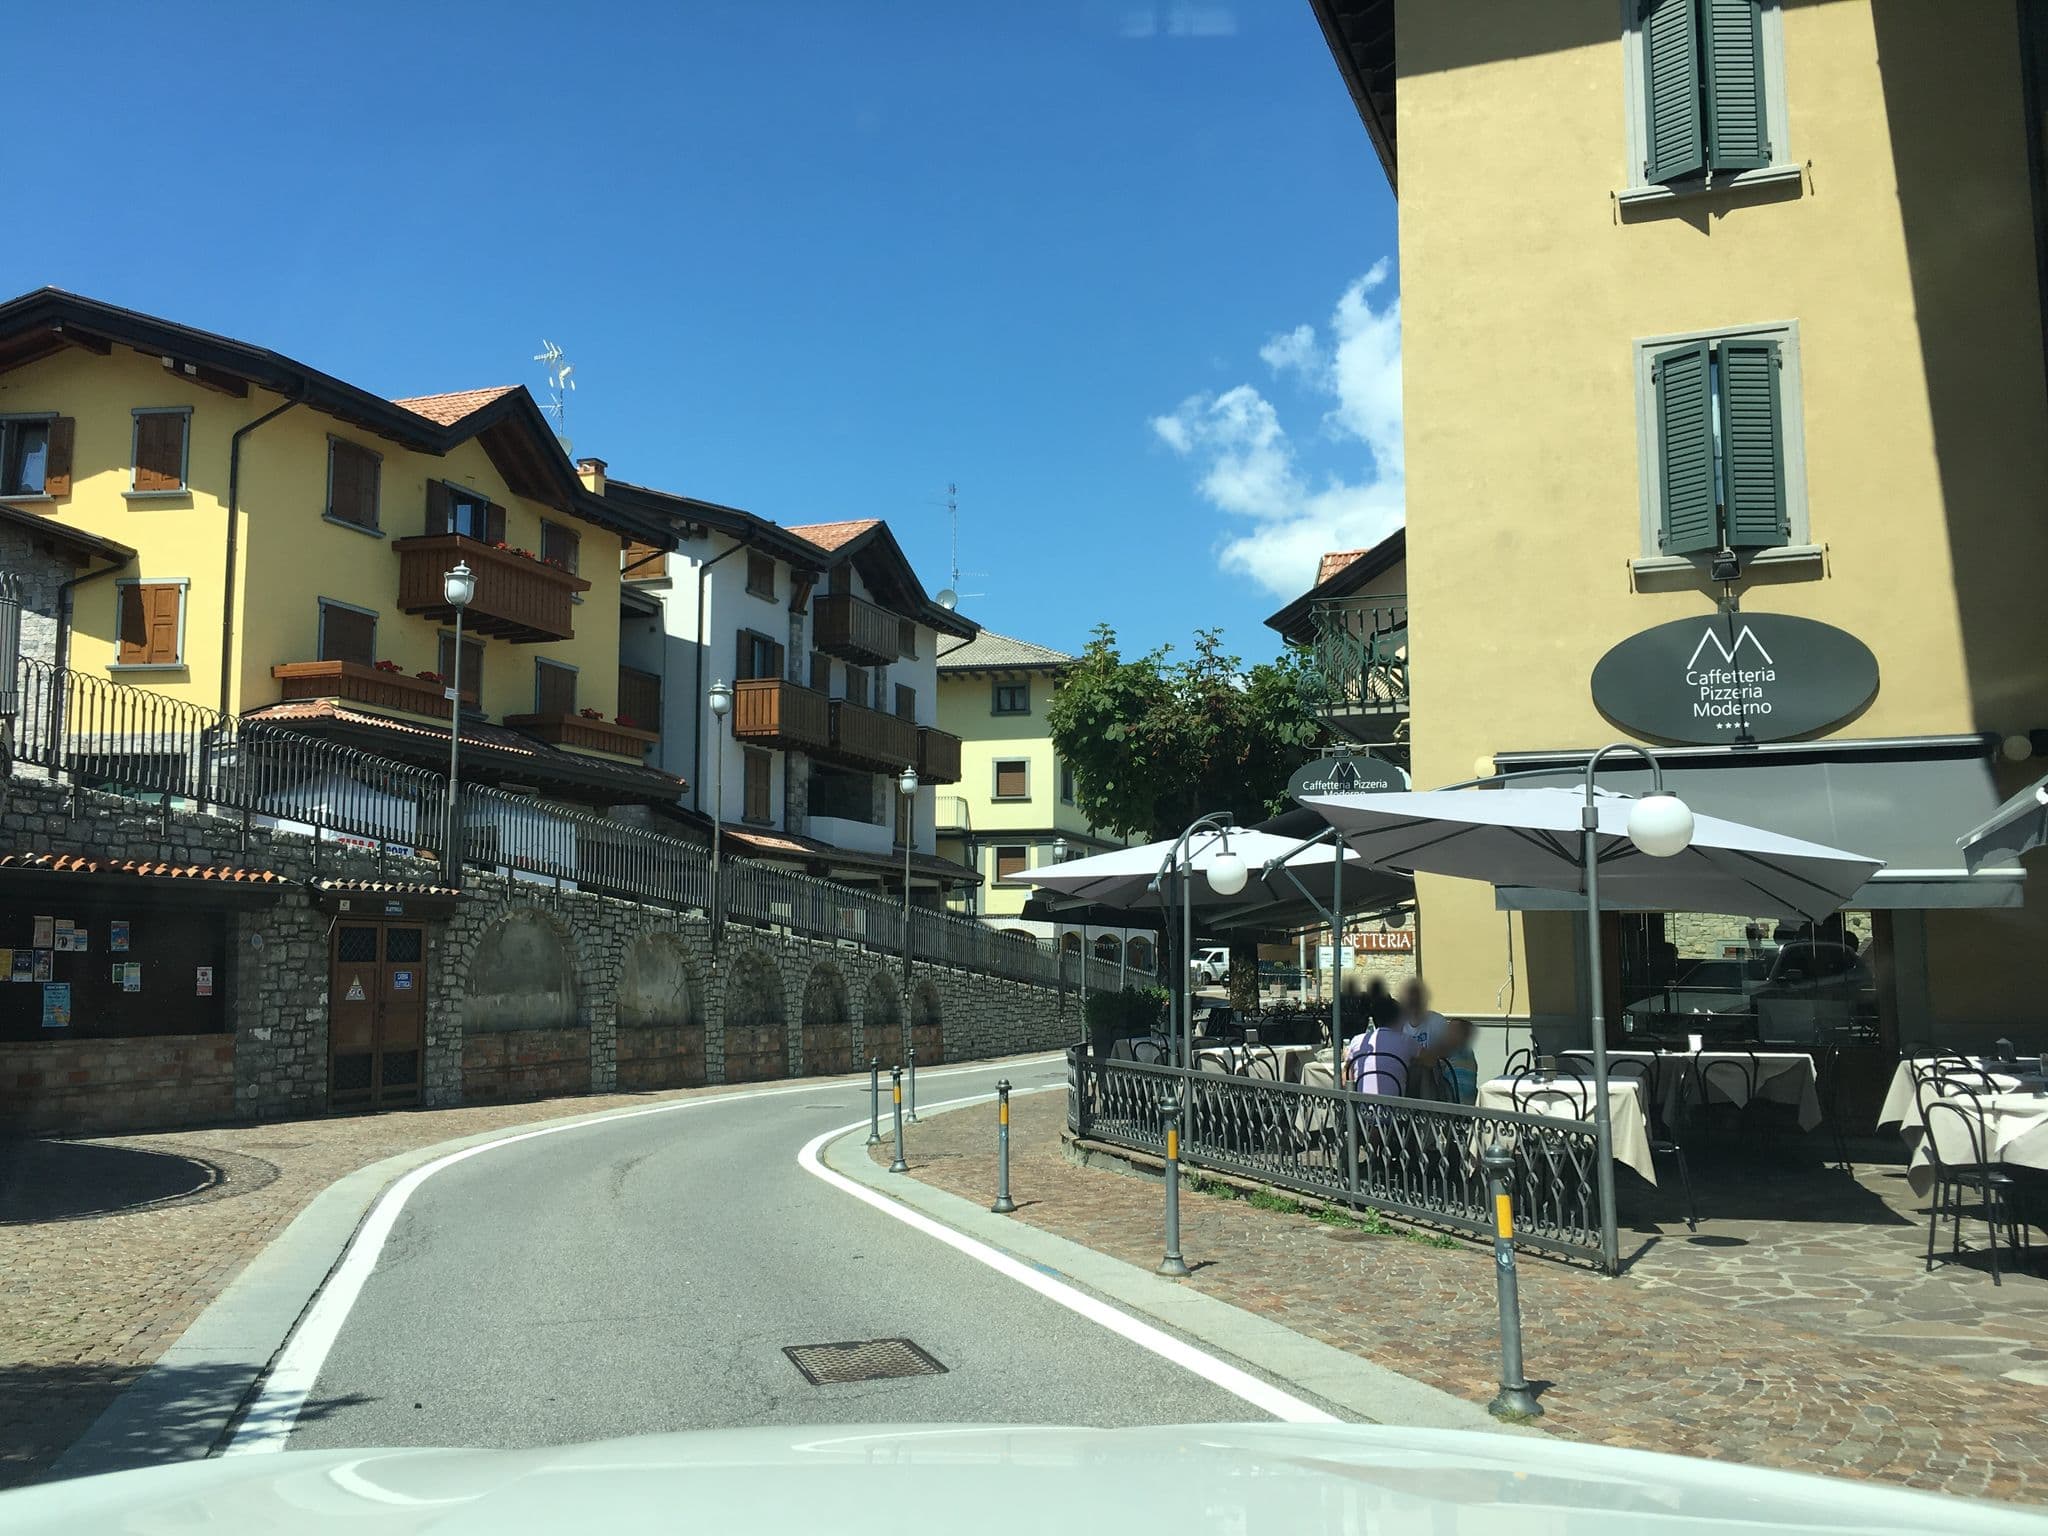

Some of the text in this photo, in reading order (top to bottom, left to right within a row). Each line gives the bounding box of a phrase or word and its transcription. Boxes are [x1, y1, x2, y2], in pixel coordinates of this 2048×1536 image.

[1686, 667, 1776, 686] Caffetteria
[1700, 684, 1763, 701] Pizzeria
[1693, 701, 1772, 717] Moderno
[1302, 779, 1388, 791] Caffetteria Pizzeria
